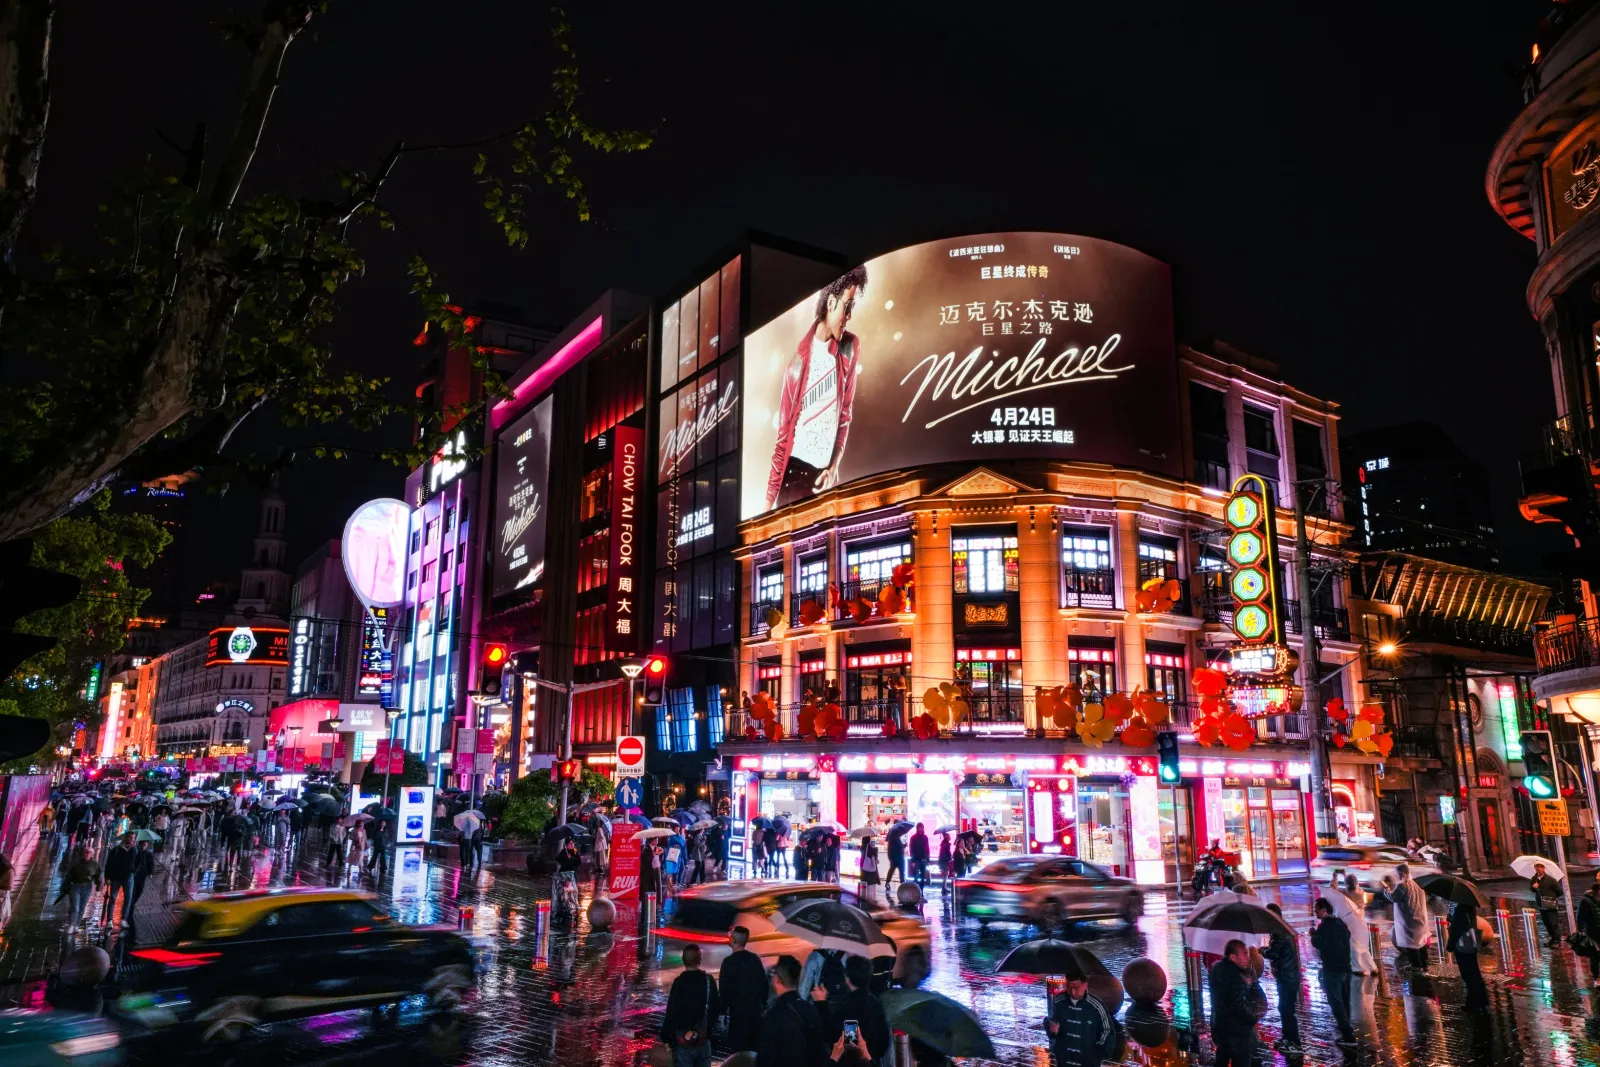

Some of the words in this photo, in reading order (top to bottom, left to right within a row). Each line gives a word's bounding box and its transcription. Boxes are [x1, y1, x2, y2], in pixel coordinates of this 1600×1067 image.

[981, 265, 1049, 279] 巨星终成传奇
[939, 299, 1094, 325] 迈克尔·杰克逊
[982, 321, 1053, 336] 巨星之路
[901, 334, 1135, 423] Michael
[990, 407, 1055, 426] 4月24日
[972, 430, 1005, 444] 大银幕
[622, 443, 635, 491] CHOW
[621, 495, 634, 518] TAI
[681, 506, 710, 532] 4月24日
[620, 523, 633, 566] FOOK
[616, 577, 632, 634] 周大福
[612, 875, 639, 889] RUN
